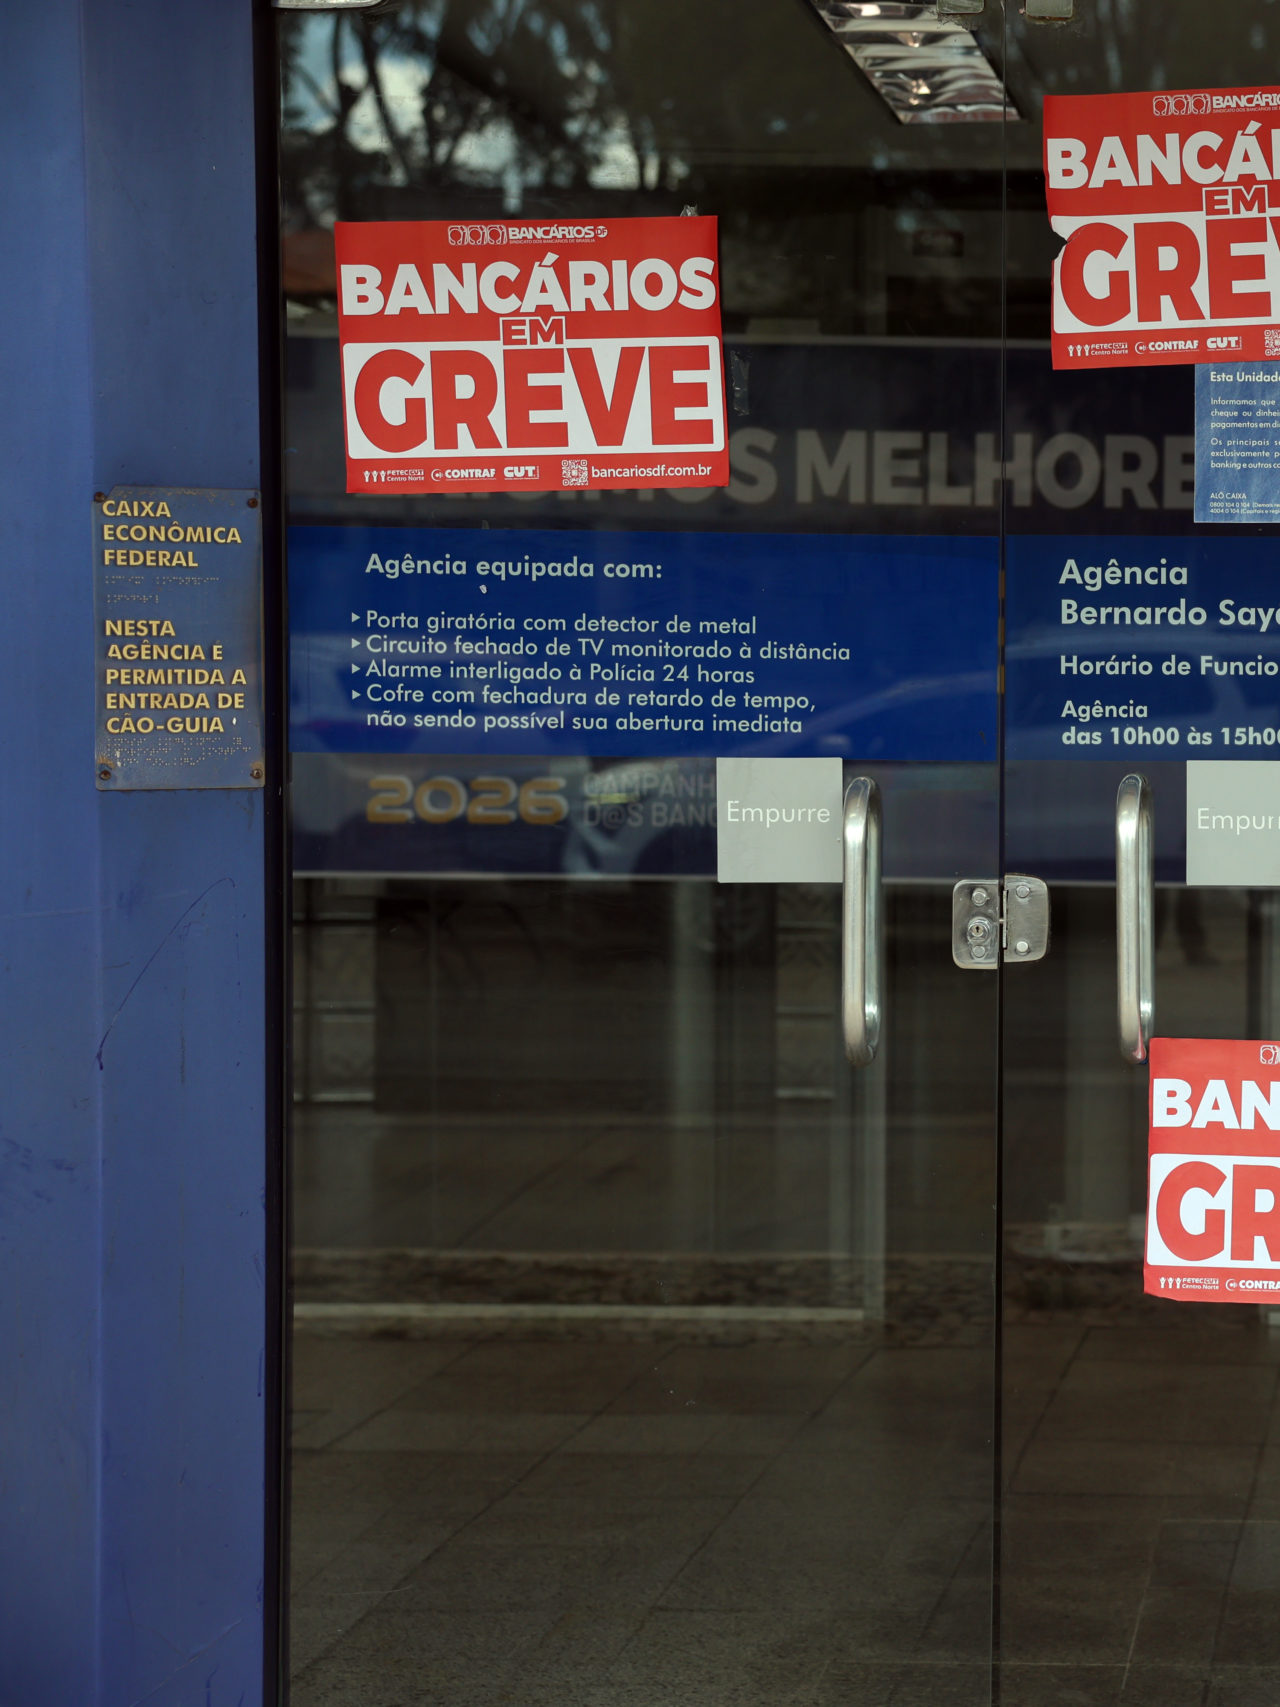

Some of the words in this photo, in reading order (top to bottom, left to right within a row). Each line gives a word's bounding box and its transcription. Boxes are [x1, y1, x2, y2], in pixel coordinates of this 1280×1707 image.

[1205, 186, 1266, 215] EM
[509, 226, 595, 239] BANCÁRIOS
[341, 252, 716, 315] BANCÁRIOS
[502, 318, 564, 346] EM
[1207, 336, 1238, 348] CUT
[1148, 339, 1199, 351] CONTRAF
[1210, 371, 1233, 382] Esta
[354, 346, 714, 452] GREVE
[445, 468, 496, 478] CONTRAF
[504, 466, 536, 478] CUT
[592, 464, 711, 479] bancariosdf.com.br
[102, 500, 171, 518] CAIXA
[104, 523, 242, 544] ECONÔMICA
[104, 549, 198, 567] FEDERAL
[365, 553, 467, 579] Agência
[476, 555, 594, 580] equipada
[603, 563, 662, 578] com:
[1059, 558, 1188, 590] Agência
[367, 610, 419, 629] Porta
[427, 611, 515, 634] giratória
[523, 618, 566, 631] com
[574, 613, 659, 633] detector
[666, 614, 691, 633] de
[699, 616, 756, 634] metal
[1061, 598, 1207, 626] Bernardo
[106, 620, 176, 637] NESTA
[108, 642, 205, 660] AGÊNCIA
[366, 634, 447, 654] Circuito
[454, 635, 538, 655] fechado
[545, 637, 571, 656] de
[577, 638, 604, 656] TV
[612, 639, 732, 659] monitorado
[739, 642, 751, 659] à
[759, 641, 850, 660] distância
[365, 659, 442, 678] Alarme
[450, 660, 562, 684] interligado
[569, 663, 581, 681] à
[590, 662, 655, 682] Polícia
[663, 664, 689, 682] 24
[698, 664, 755, 684] horas
[1060, 654, 1153, 675] Horário
[1161, 654, 1191, 676] de
[106, 669, 225, 685] PERMITIDA
[231, 669, 247, 685] A
[106, 693, 210, 709] ENTRADA
[218, 693, 244, 709] DE
[366, 684, 424, 703] Cofre
[432, 690, 475, 711] com
[482, 686, 587, 712] fechadura
[595, 687, 621, 706] de
[628, 688, 704, 713] retardo
[711, 689, 736, 708] de
[743, 692, 815, 713] tempo,
[367, 710, 407, 727] não
[413, 710, 476, 728] sendo
[484, 712, 565, 733] possível
[572, 717, 608, 730] sua
[615, 713, 704, 731] abertura
[713, 714, 802, 733] imediata
[1061, 699, 1148, 723] Agência
[107, 713, 224, 734] CÃO-GUIA
[1062, 726, 1102, 745] das
[1110, 726, 1180, 745] 10h00
[1187, 726, 1213, 745] às
[367, 775, 567, 825] 2026
[727, 799, 831, 827] Empurre
